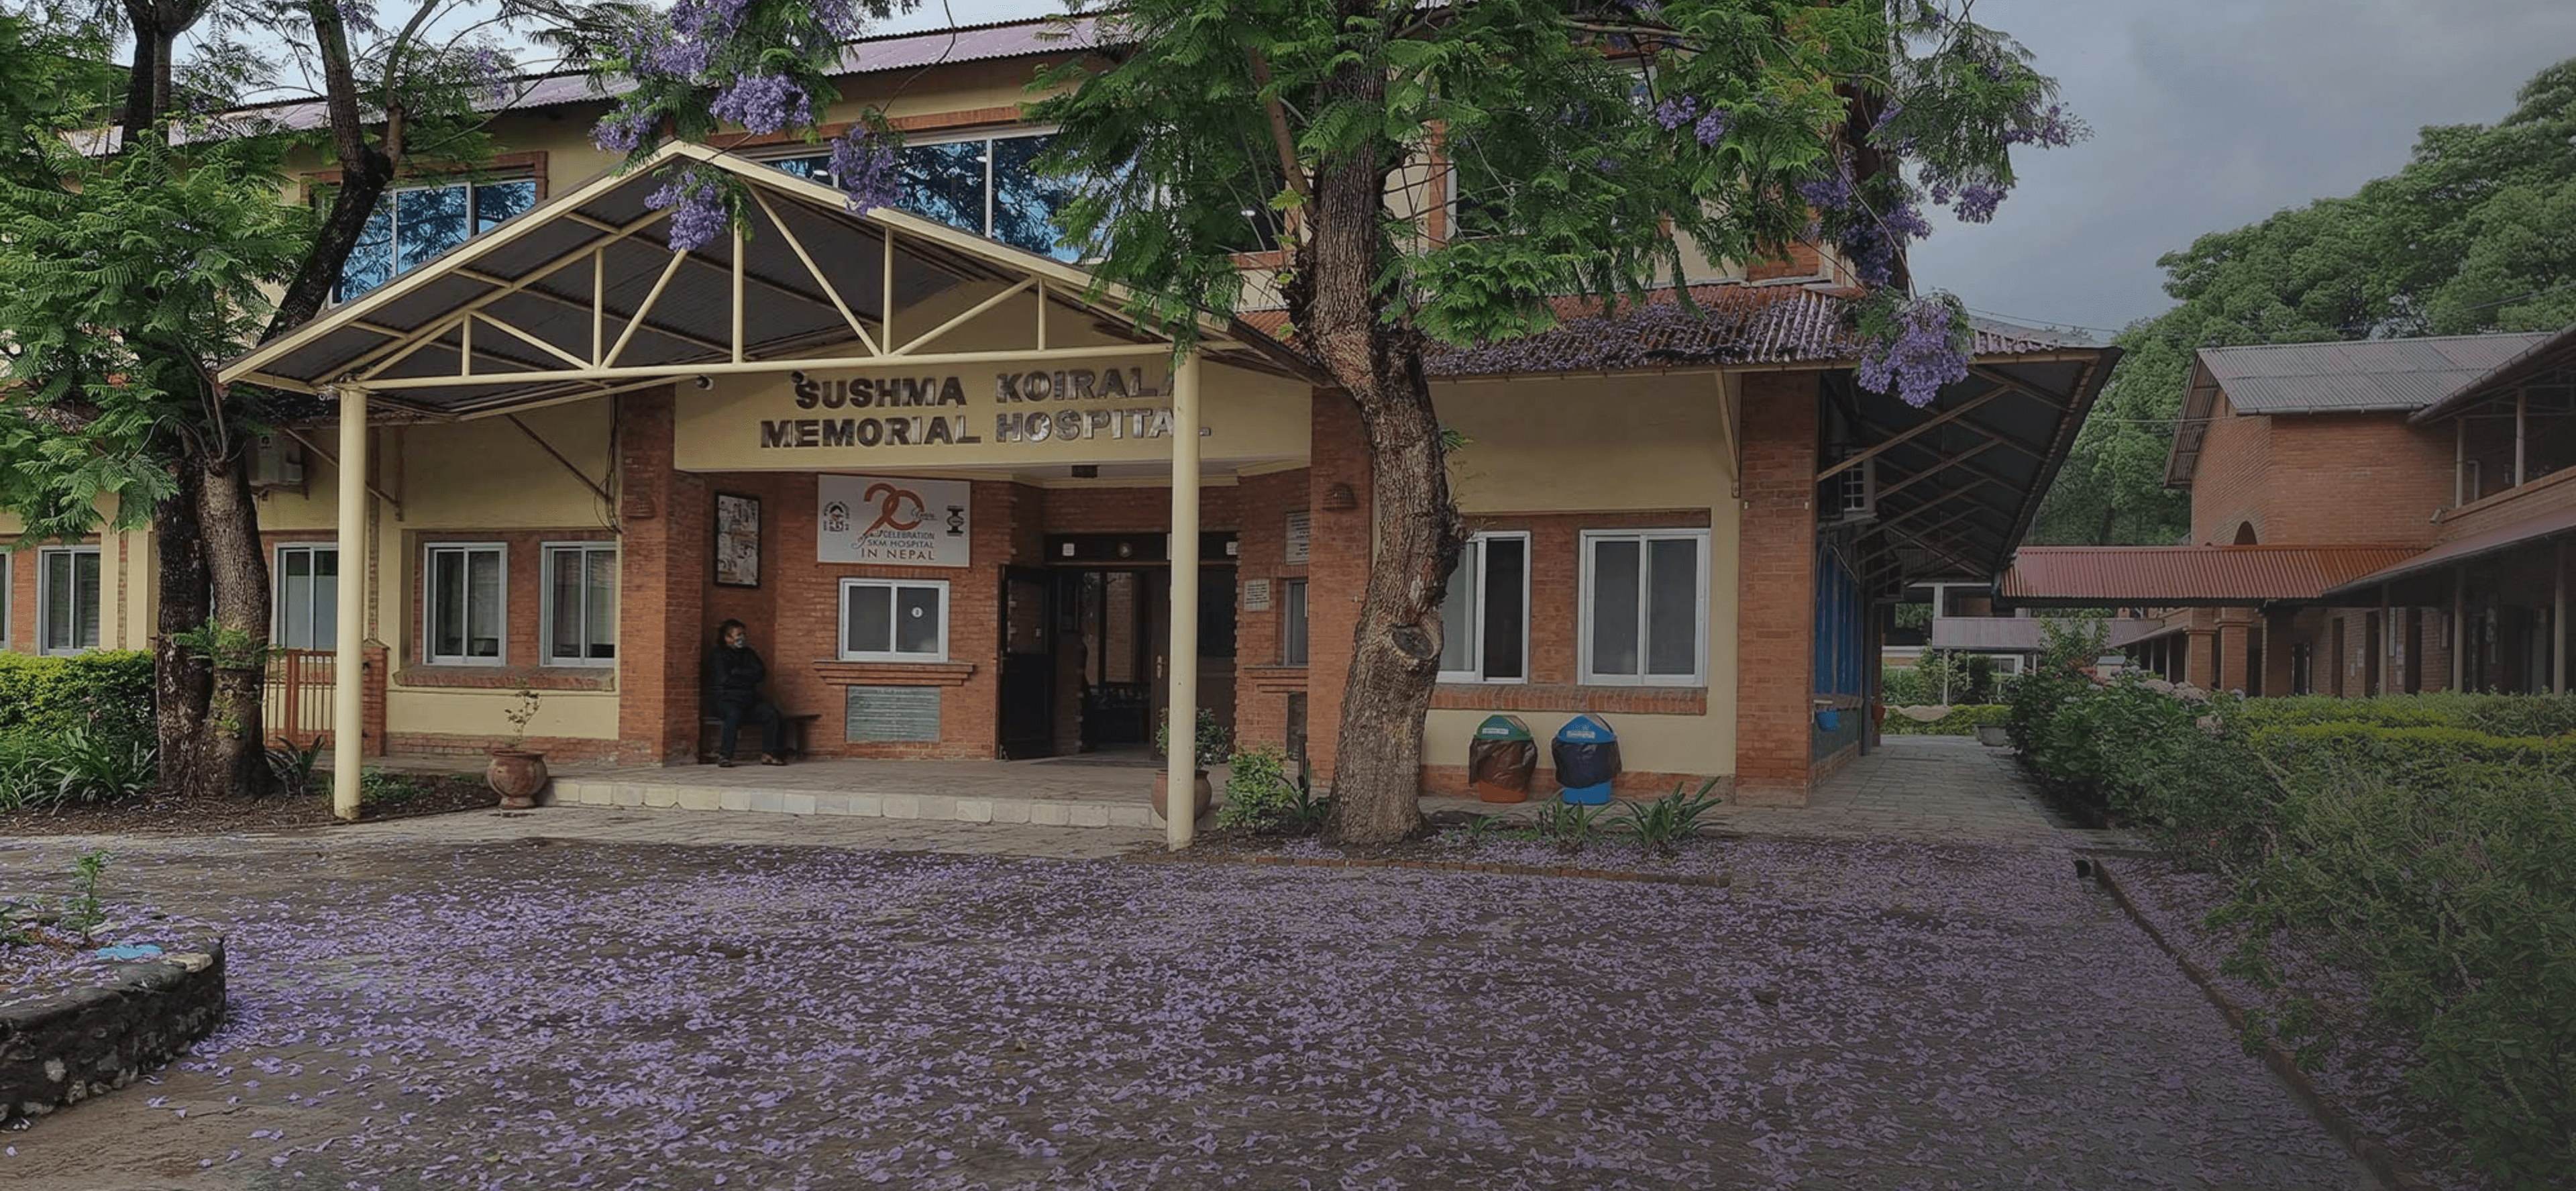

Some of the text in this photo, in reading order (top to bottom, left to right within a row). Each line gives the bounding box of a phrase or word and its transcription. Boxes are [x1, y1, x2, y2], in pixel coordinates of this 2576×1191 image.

[795, 377, 967, 409] SUSHMA
[761, 407, 1212, 448] MEMORIAL HOSPITA
[883, 530, 934, 539] CELEBRATION
[890, 539, 934, 548] HOSPITAL
[861, 548, 935, 560] IN NEPAL
